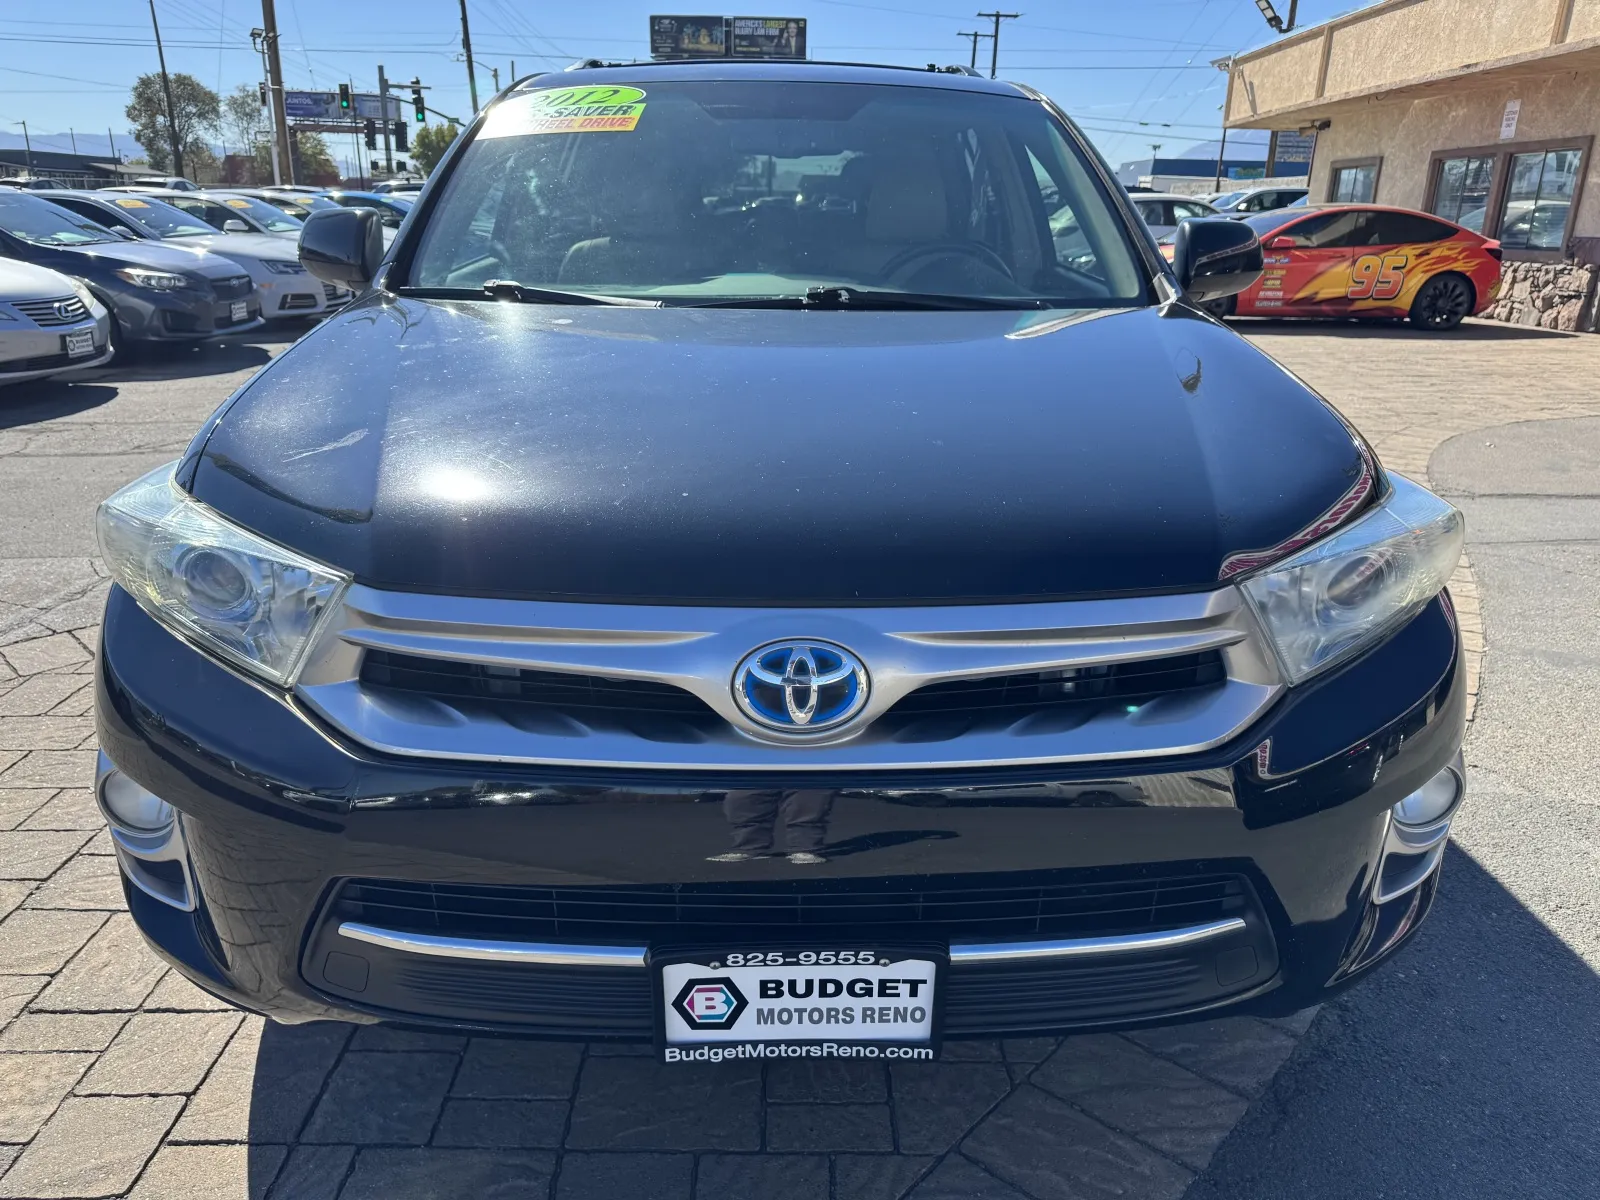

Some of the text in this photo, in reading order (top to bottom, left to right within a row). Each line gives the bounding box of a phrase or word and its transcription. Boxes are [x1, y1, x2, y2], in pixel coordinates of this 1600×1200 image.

[534, 91, 620, 108] 2012
[579, 117, 635, 128] DRIVE
[1348, 254, 1409, 300] 95
[726, 951, 876, 967] 825-9555
[693, 978, 927, 1016] B BUDGET
[756, 1006, 926, 1025] MOTORS RENO
[664, 1043, 934, 1063] BudgetMotorsReno.com
